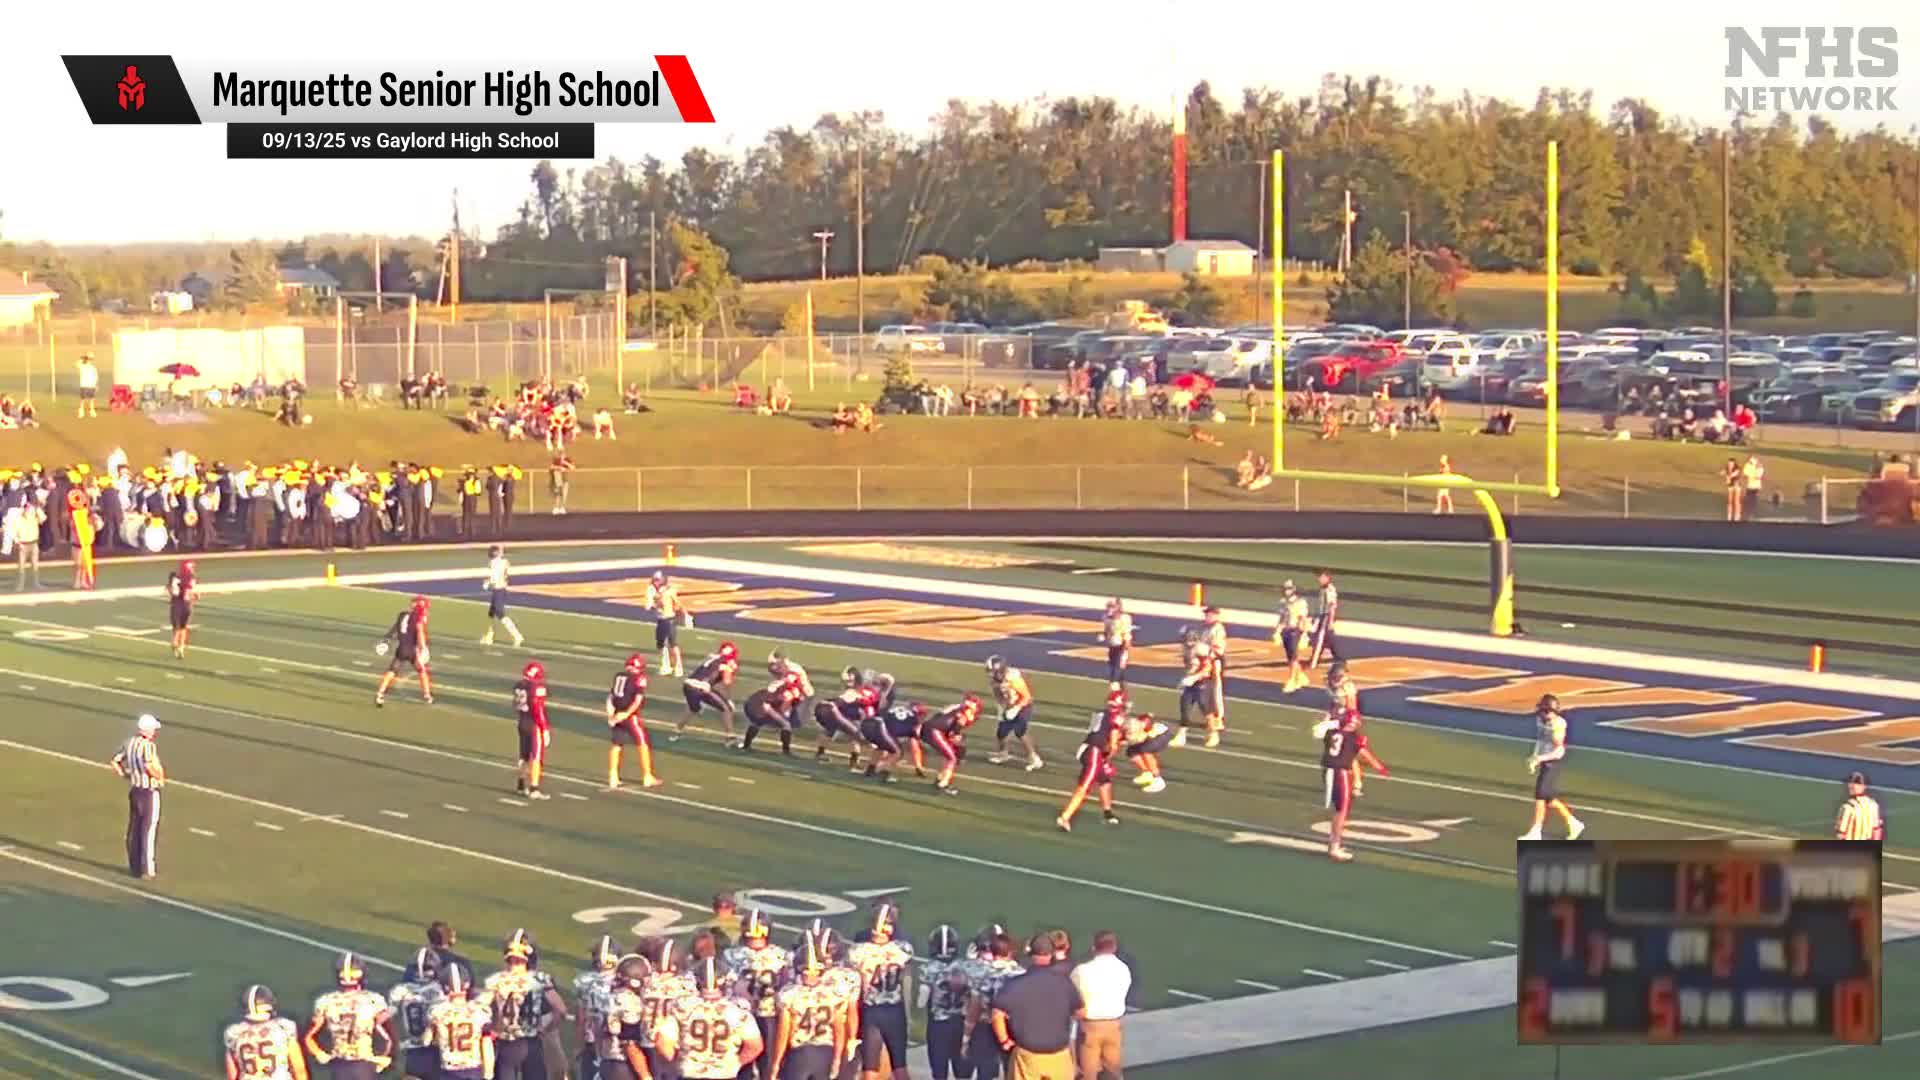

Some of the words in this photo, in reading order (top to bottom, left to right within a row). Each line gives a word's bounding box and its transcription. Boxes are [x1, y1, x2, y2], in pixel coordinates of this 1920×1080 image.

[1329, 733, 1344, 757] 3
[572, 888, 857, 936] 20
[445, 1022, 474, 1052] 12
[690, 1019, 730, 1054] 92
[799, 1005, 832, 1038] 42
[239, 1040, 277, 1078] 65
